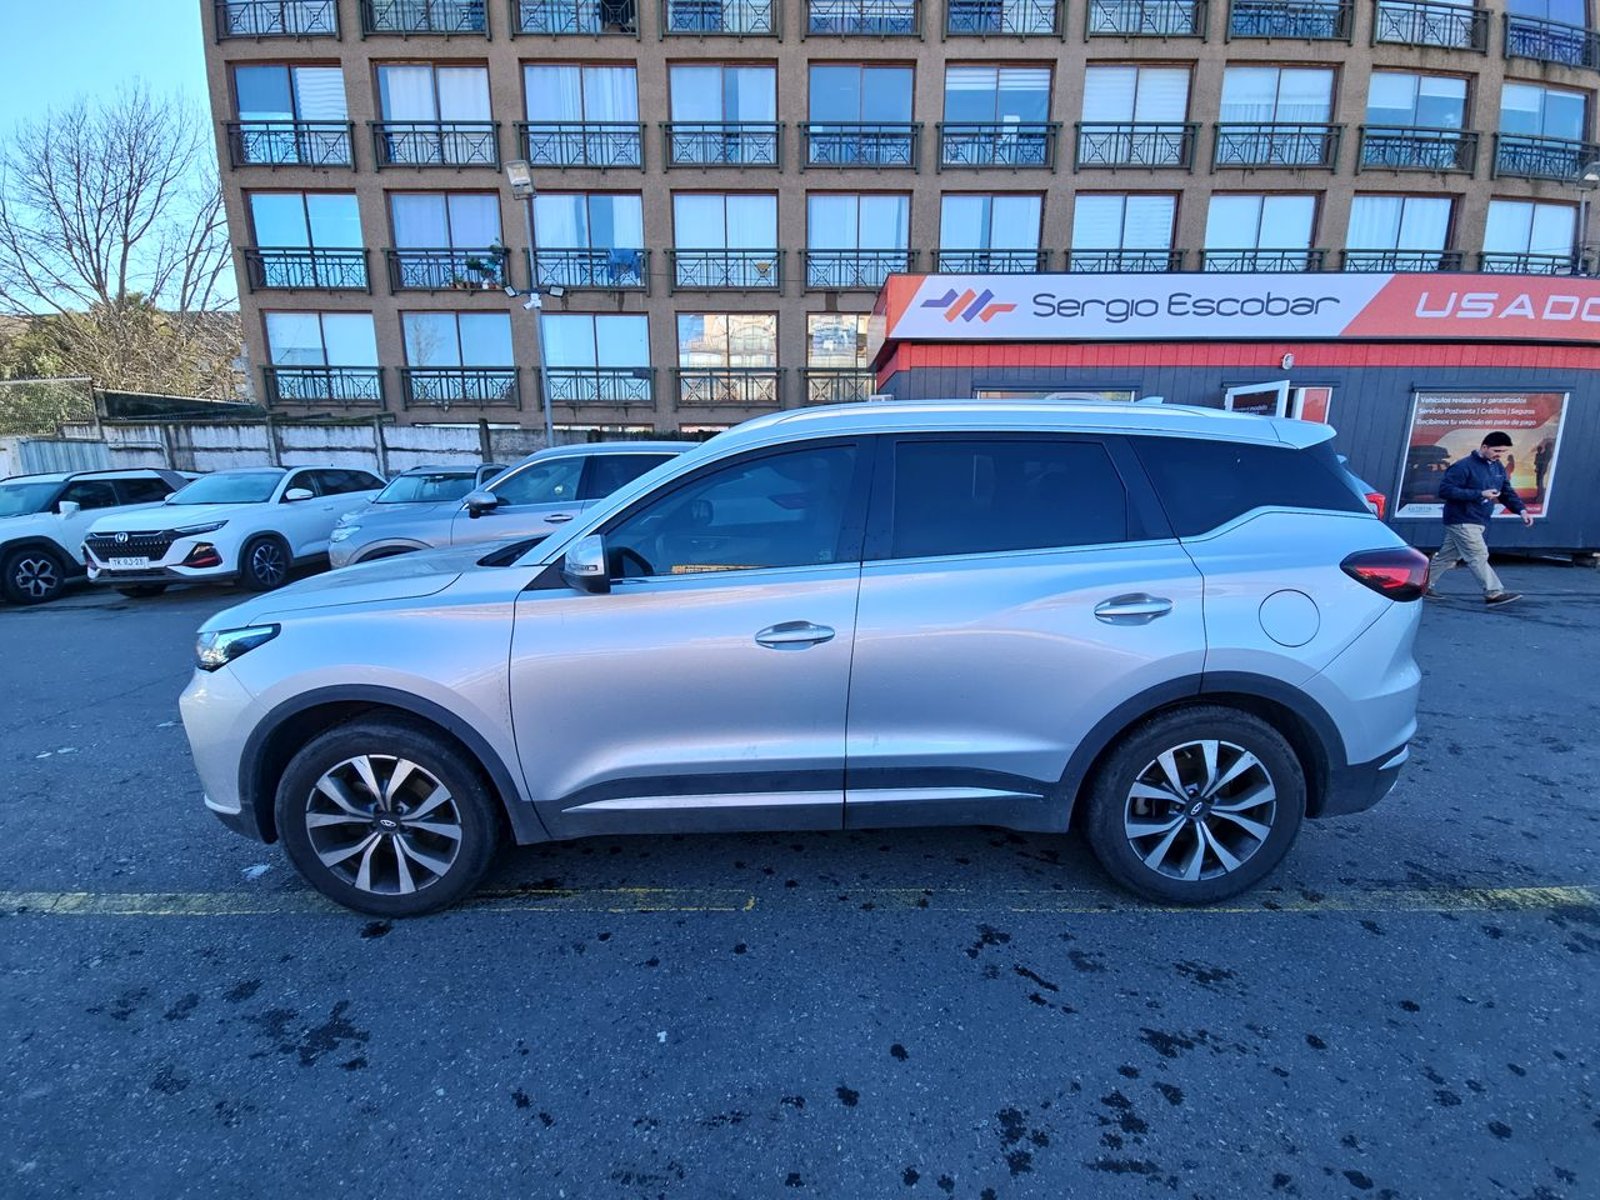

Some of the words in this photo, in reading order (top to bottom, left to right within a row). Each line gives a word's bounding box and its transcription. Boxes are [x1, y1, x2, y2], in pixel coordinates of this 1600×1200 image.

[1032, 293, 1160, 323] Sergio
[1167, 291, 1341, 316] Escobar
[1487, 397, 1527, 405] garantizados
[1510, 408, 1536, 416] Seguros
